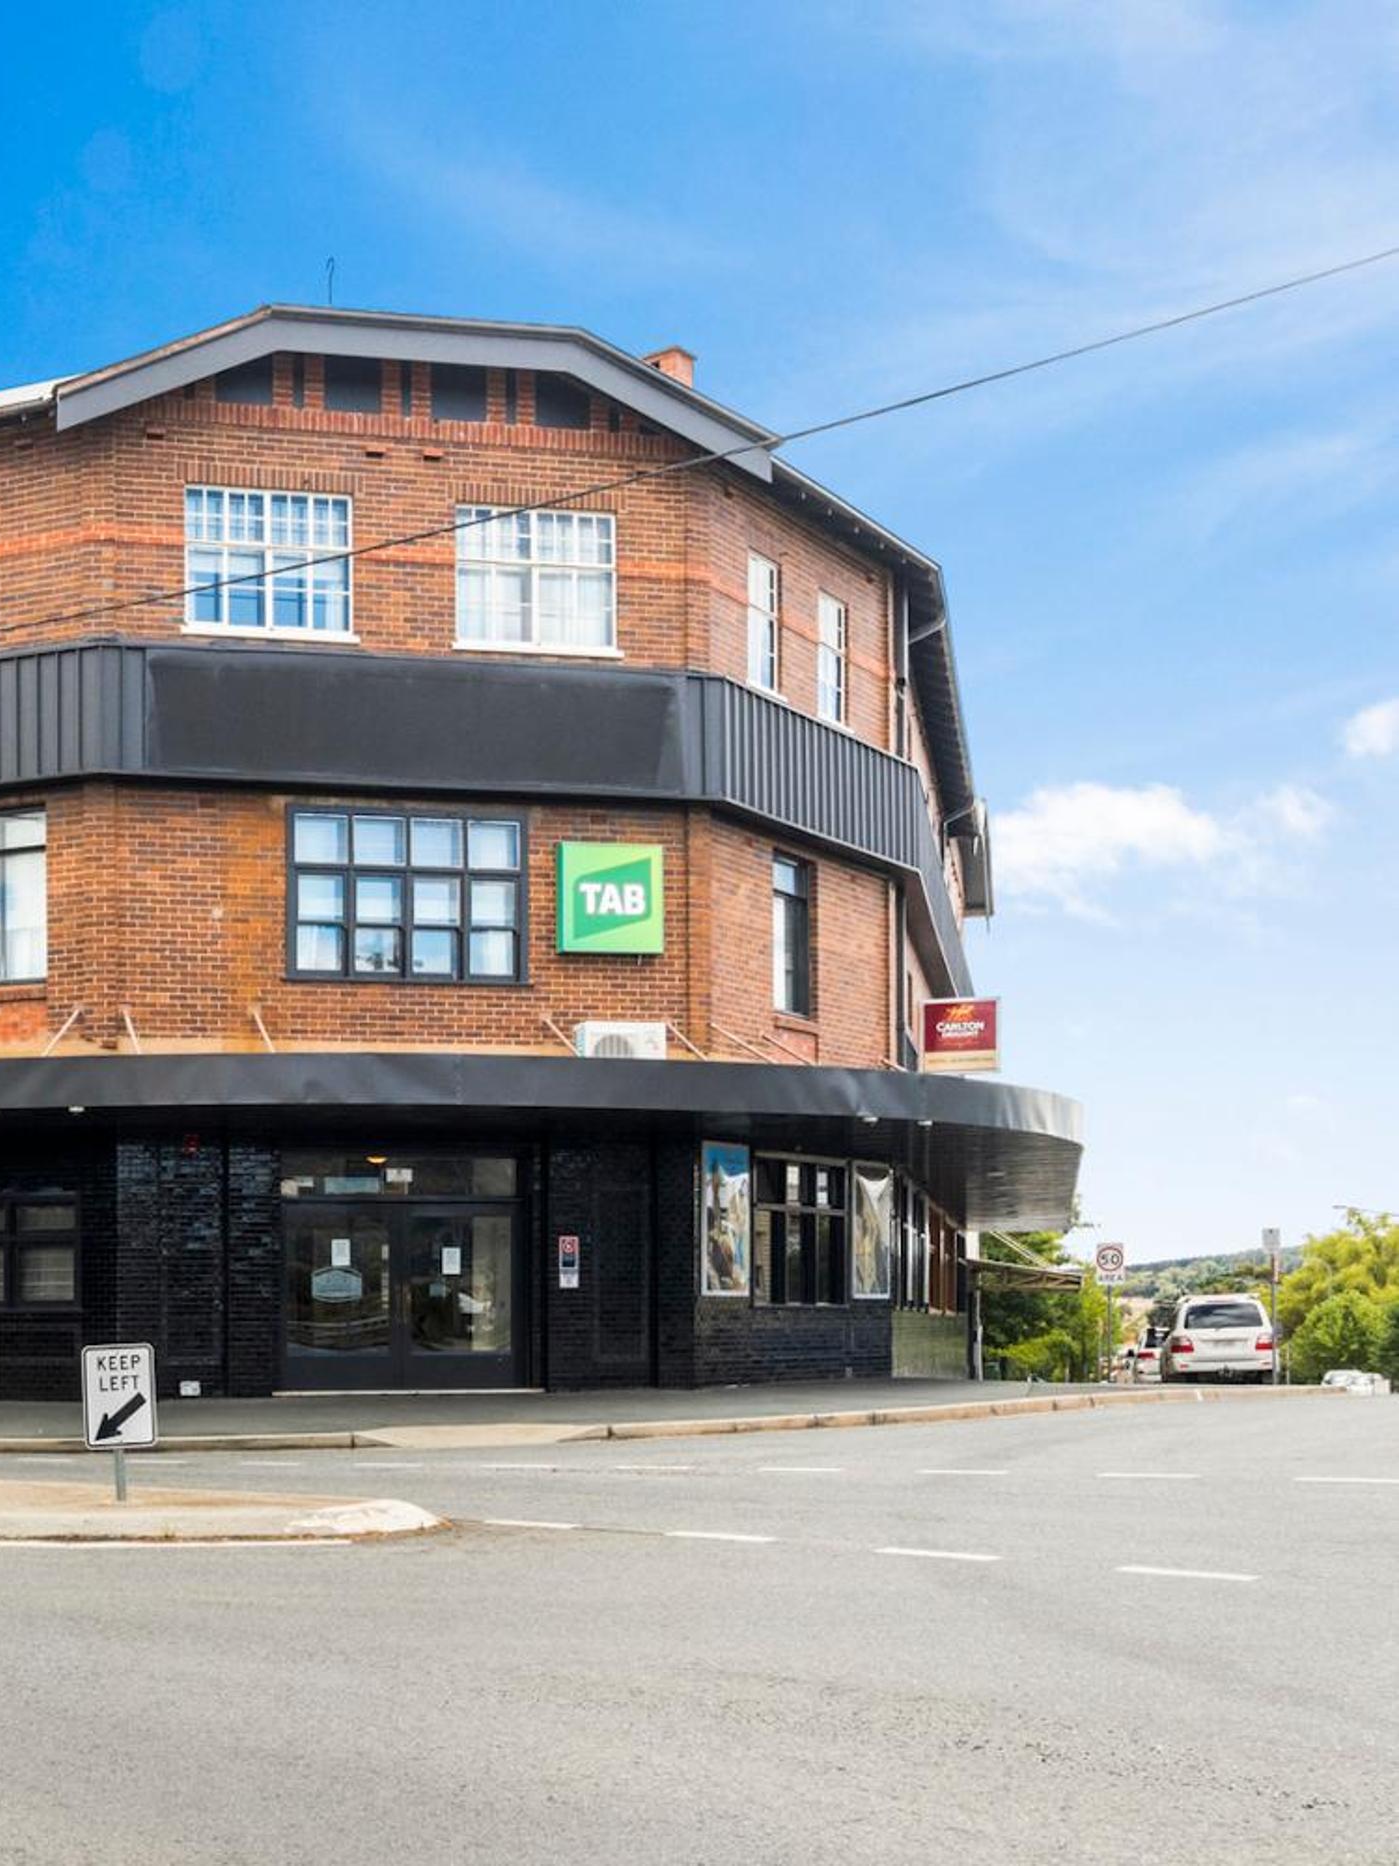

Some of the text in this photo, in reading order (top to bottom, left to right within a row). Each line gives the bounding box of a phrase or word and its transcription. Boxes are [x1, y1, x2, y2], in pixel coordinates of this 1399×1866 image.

[579, 883, 646, 915] TAB
[1101, 1253, 1119, 1265] 50
[97, 1354, 141, 1371] KEEP
[99, 1375, 139, 1392] LEFT
